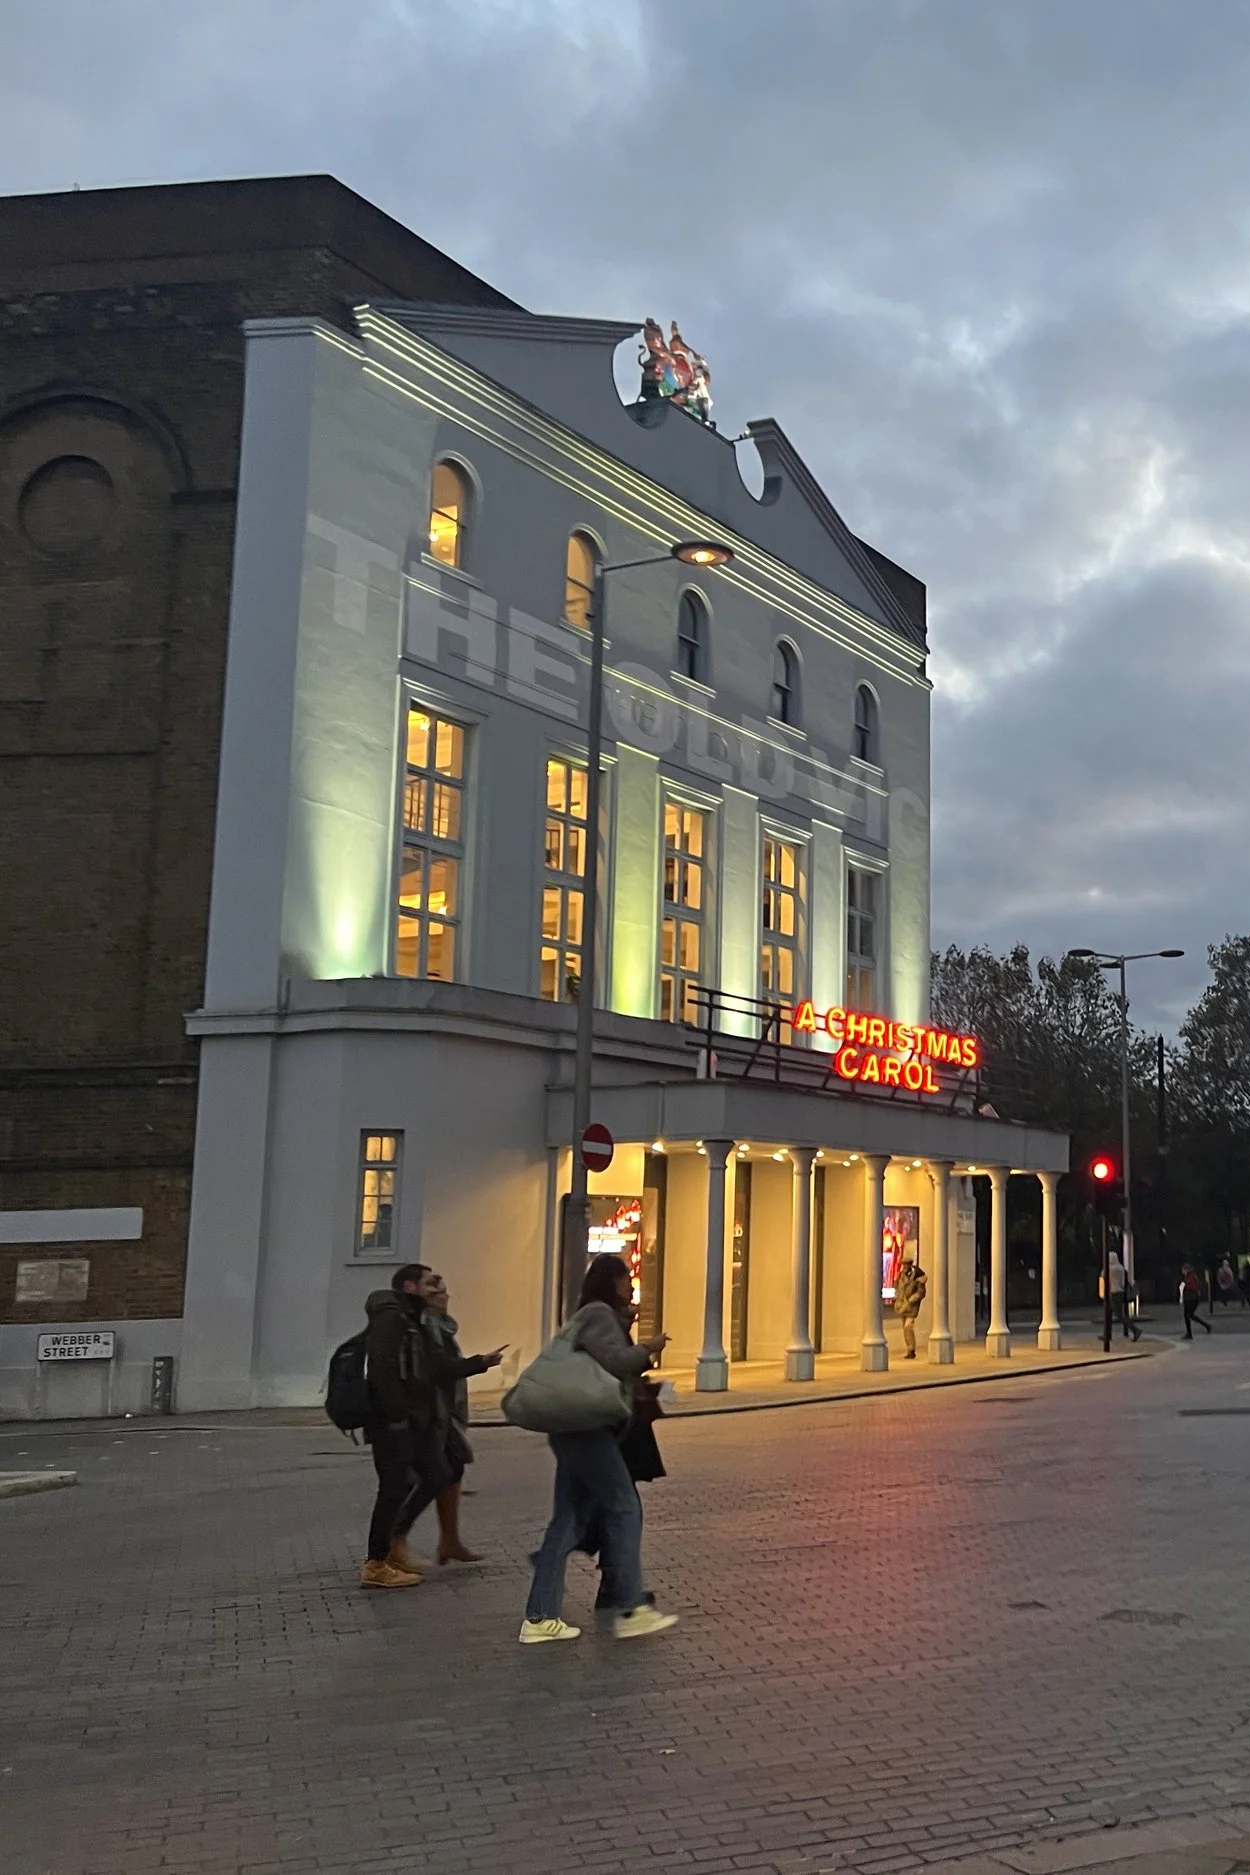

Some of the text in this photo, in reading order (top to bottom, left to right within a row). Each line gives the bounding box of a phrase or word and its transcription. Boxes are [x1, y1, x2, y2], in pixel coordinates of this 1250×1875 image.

[305, 513, 928, 861] THE OLD VIC
[795, 1000, 978, 1067] A CHRISTMAS
[837, 1047, 940, 1093] CAROL
[43, 1346, 90, 1358] STREET
[51, 1334, 101, 1346] WEBBER
